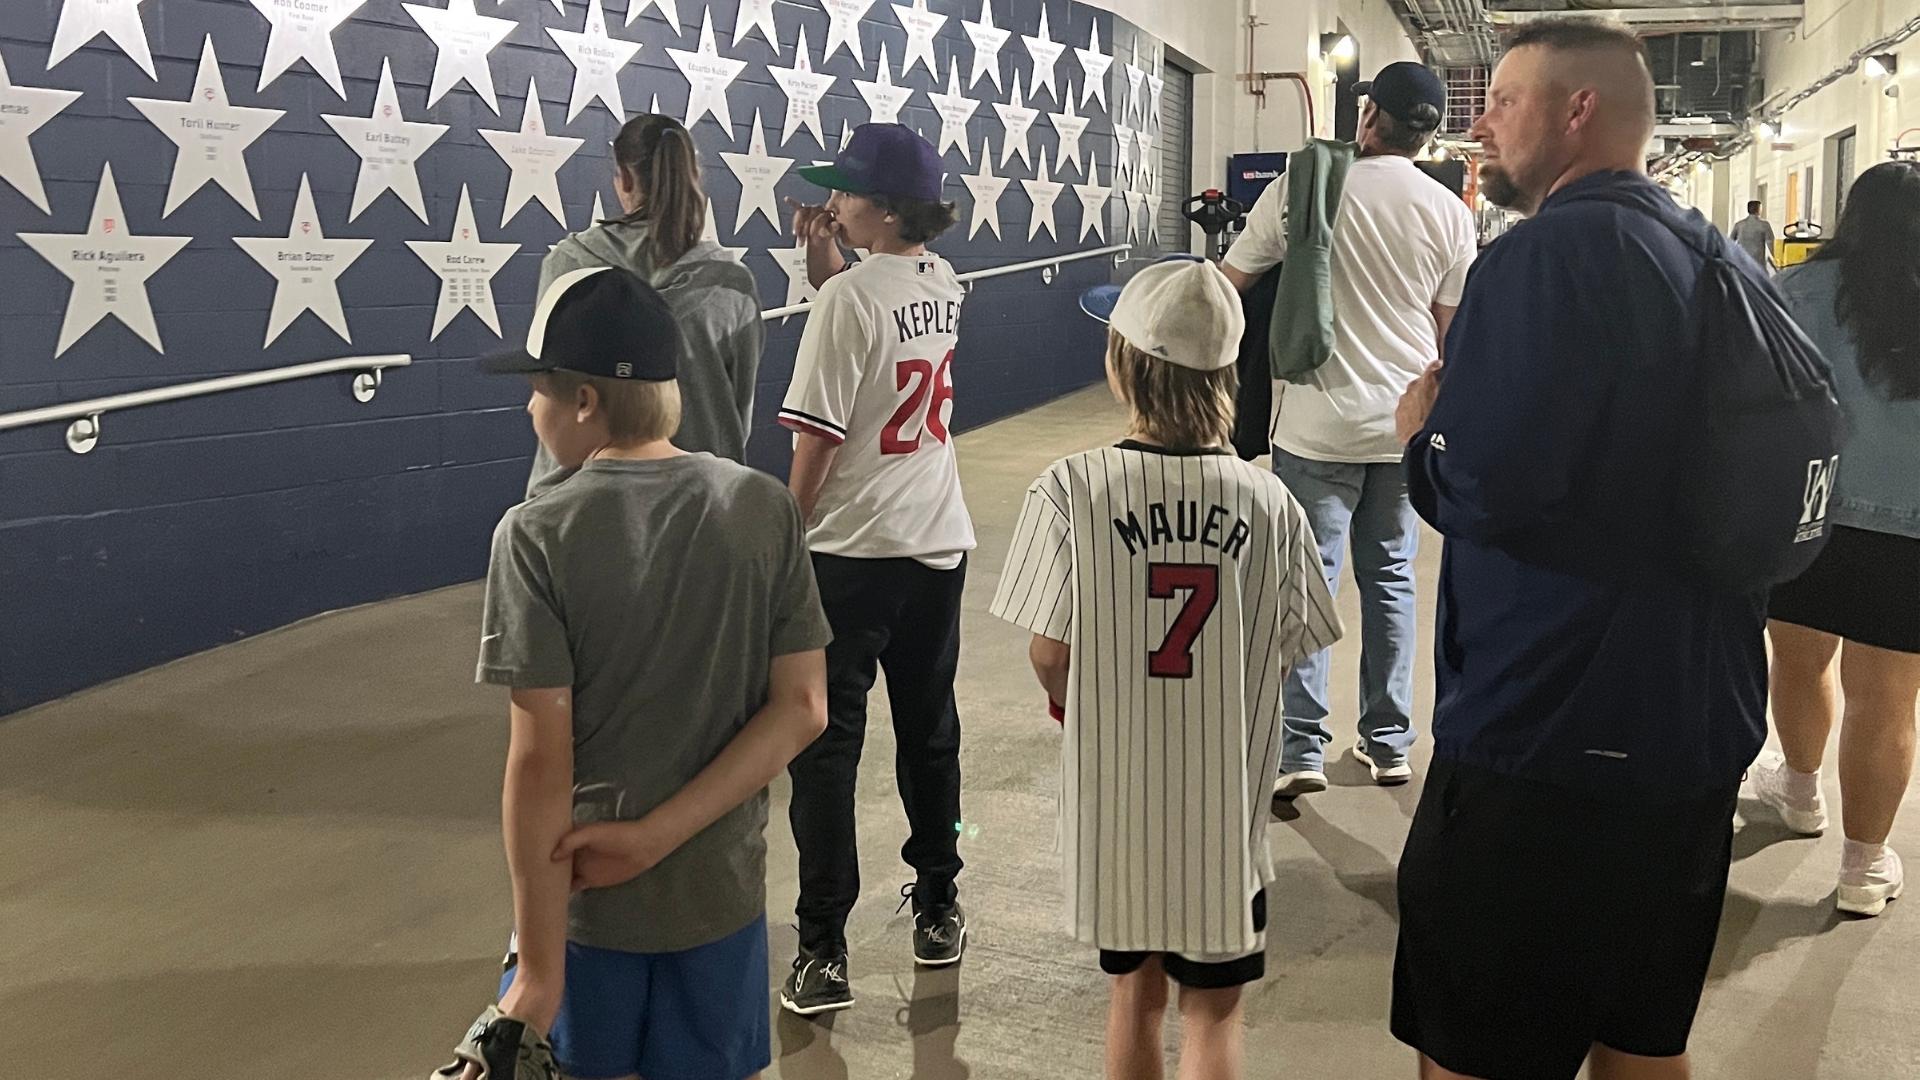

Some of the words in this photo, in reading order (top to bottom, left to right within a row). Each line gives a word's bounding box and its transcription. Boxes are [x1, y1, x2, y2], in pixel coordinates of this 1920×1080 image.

[294, 0, 329, 13] Coomer
[578, 45, 592, 55] Rich
[593, 47, 615, 58] Rollins
[688, 62, 711, 73] Eduardo
[181, 117, 204, 129] Torii
[206, 119, 241, 131] Hunter
[366, 132, 382, 142] Earl
[384, 133, 410, 146] Battey
[72, 250, 96, 261] Rick
[98, 250, 145, 264] Aguilera
[278, 251, 303, 261] Brian
[305, 251, 335, 261] Dozier
[446, 255, 462, 264] Rod
[463, 255, 486, 265] Carew
[880, 348, 955, 456] 26
[1113, 500, 1250, 560] MAUER
[1148, 561, 1219, 679] 7
